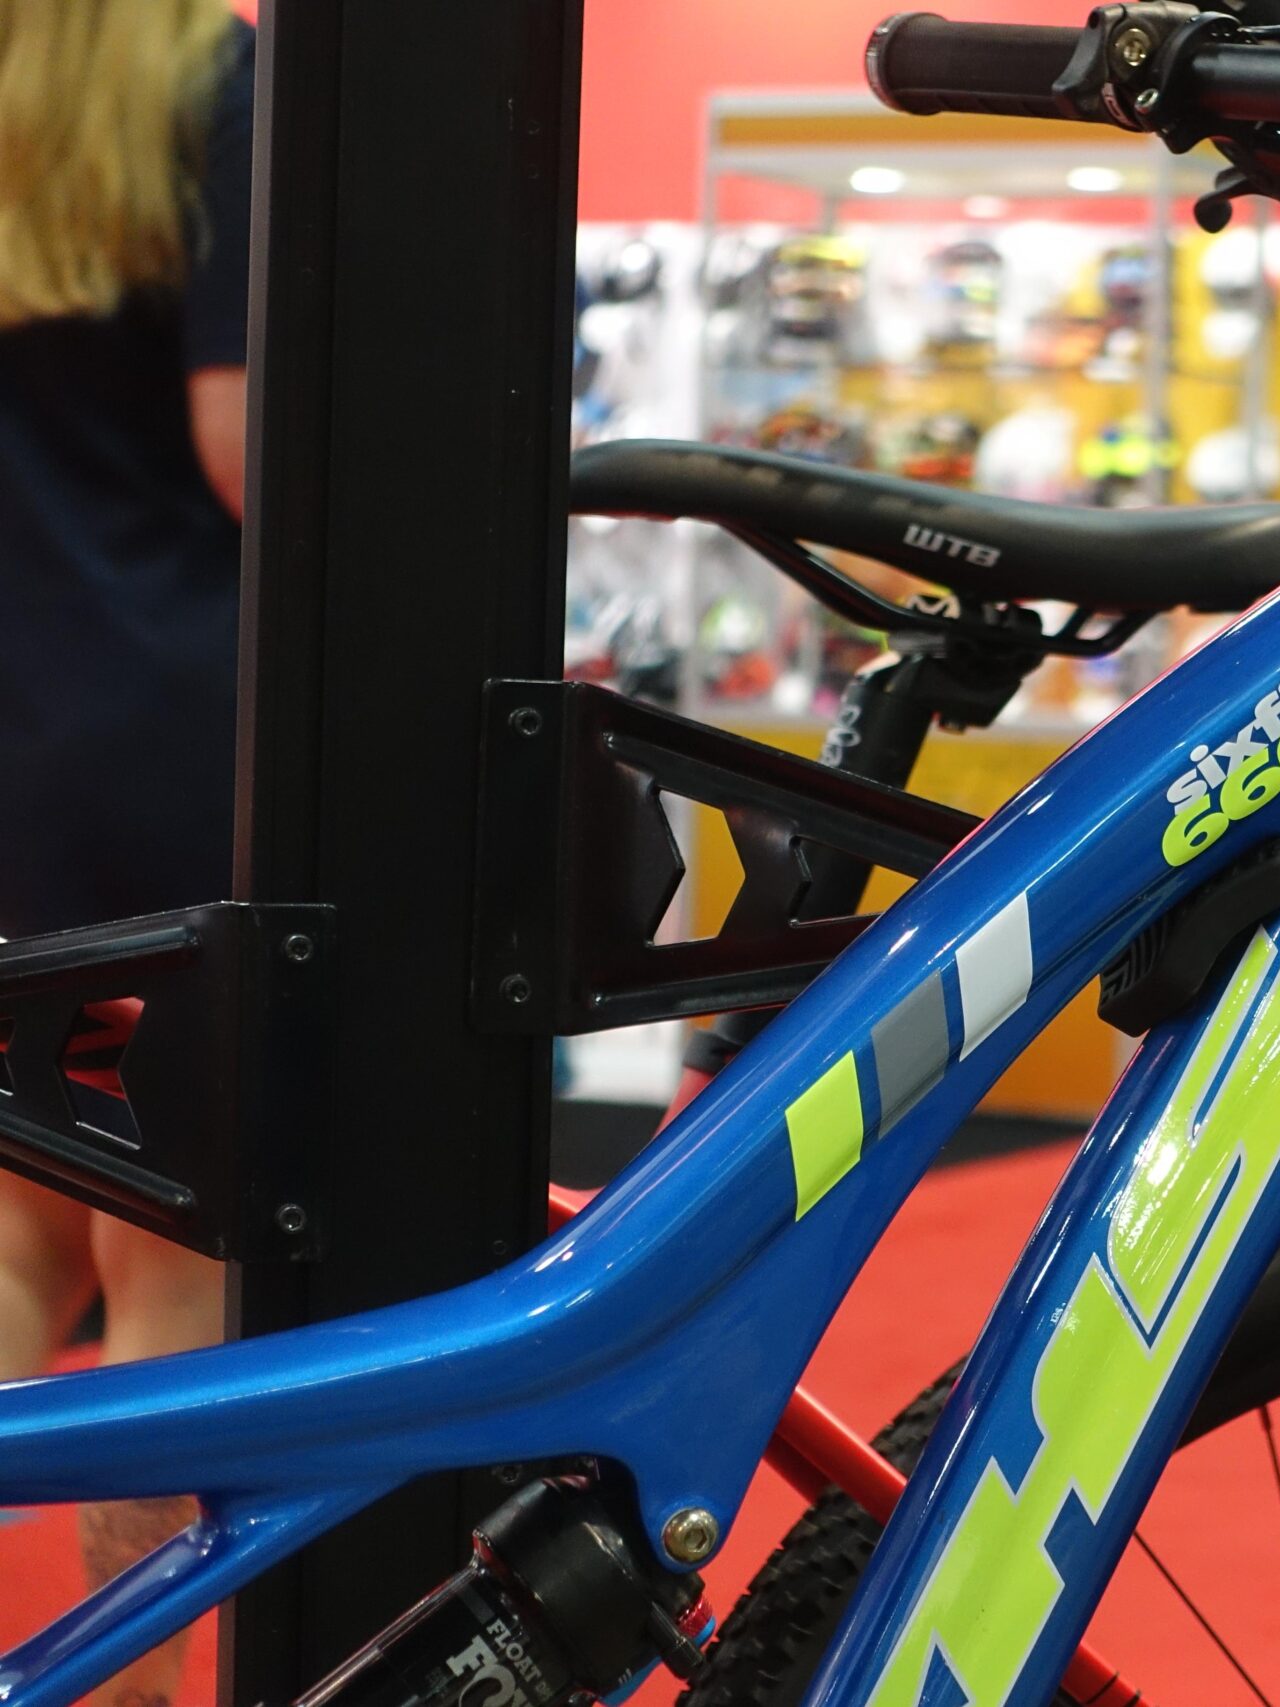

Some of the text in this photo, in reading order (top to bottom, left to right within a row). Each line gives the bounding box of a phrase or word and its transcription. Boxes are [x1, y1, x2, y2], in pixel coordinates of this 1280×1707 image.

[903, 524, 1000, 567] WTB
[446, 1635, 533, 1707] FO
[486, 1618, 542, 1683] FLOAT
